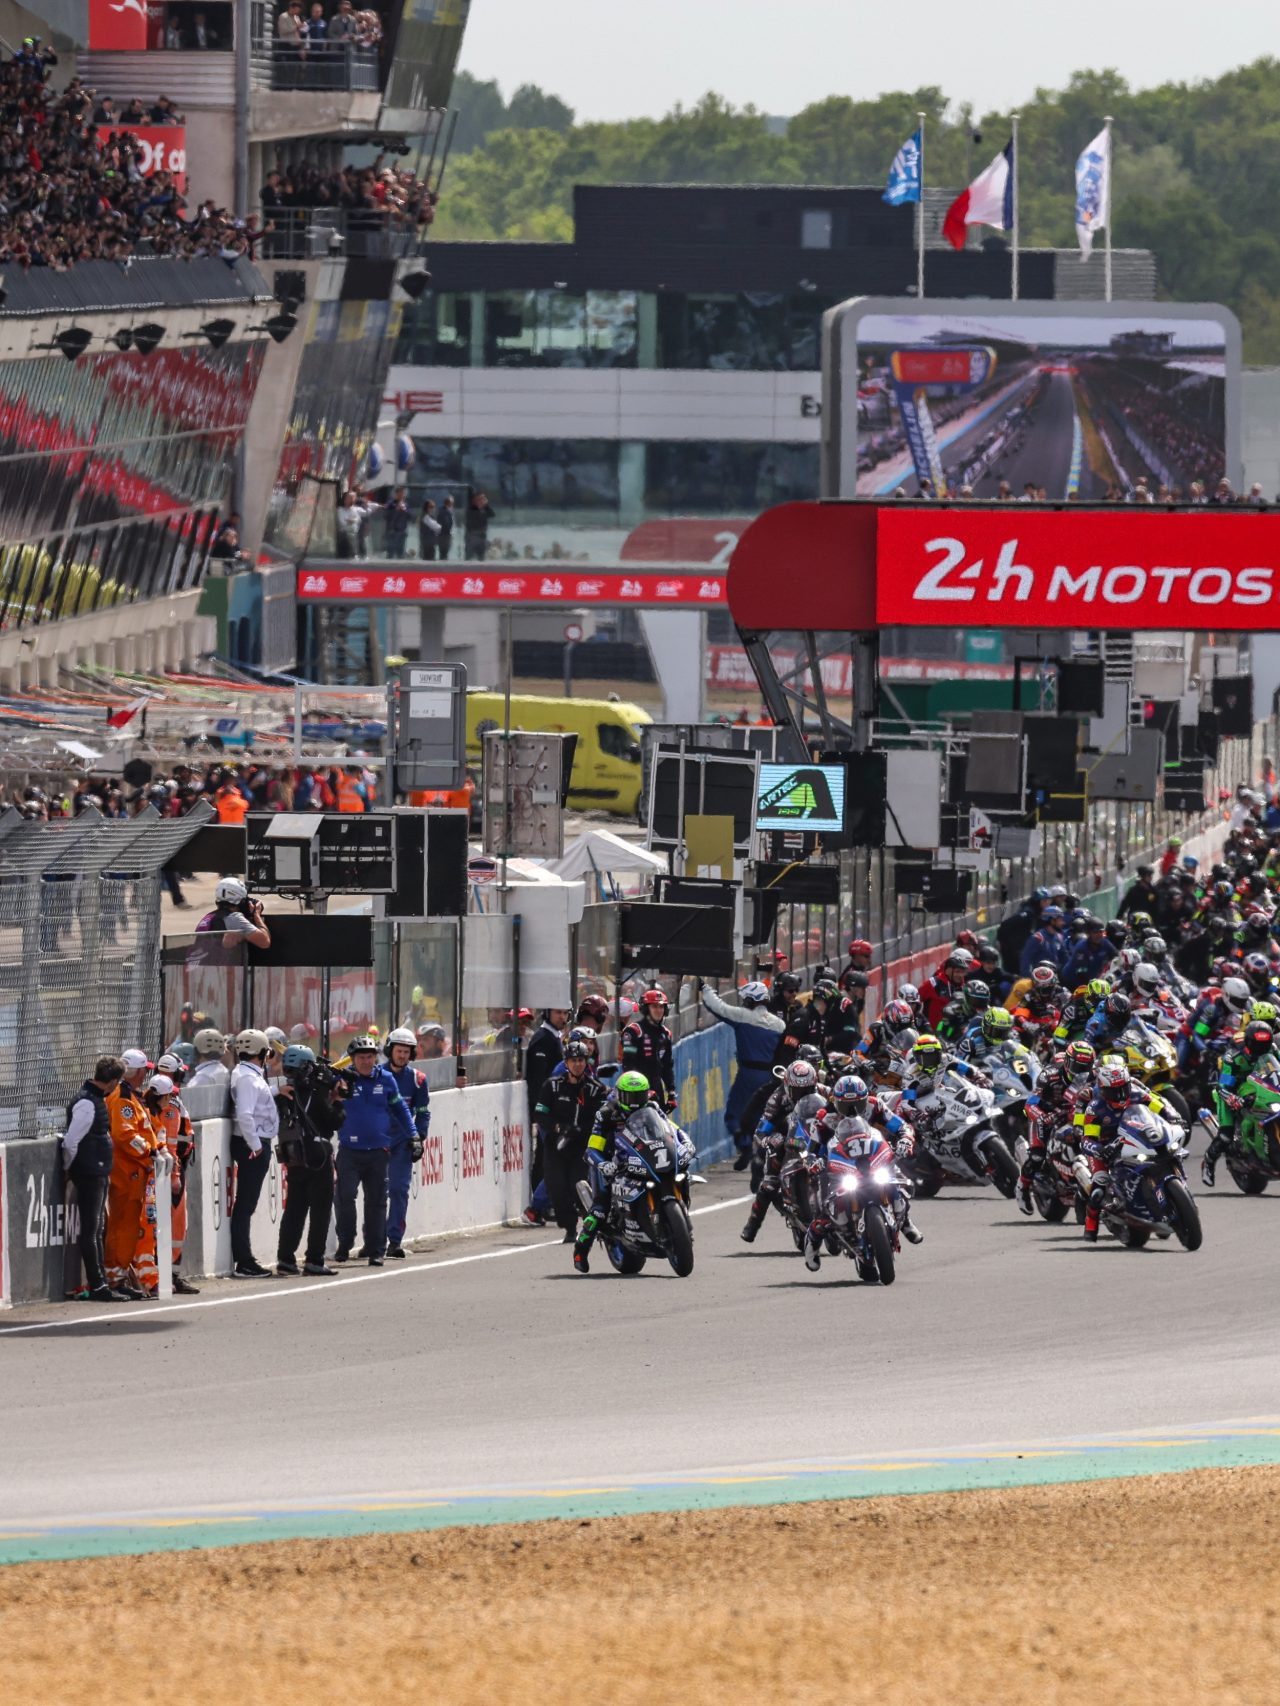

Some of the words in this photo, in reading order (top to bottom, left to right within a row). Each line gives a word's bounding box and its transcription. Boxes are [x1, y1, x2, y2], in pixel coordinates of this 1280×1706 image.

[912, 537, 1034, 601] 24h
[1047, 566, 1273, 605] MOTOS
[462, 1129, 484, 1178] BOSCH
[502, 1123, 524, 1173] BOSCH
[654, 1148, 671, 1169] 1
[847, 1138, 872, 1158] 37
[26, 1173, 49, 1249] 24h
[49, 1204, 64, 1247] LE
